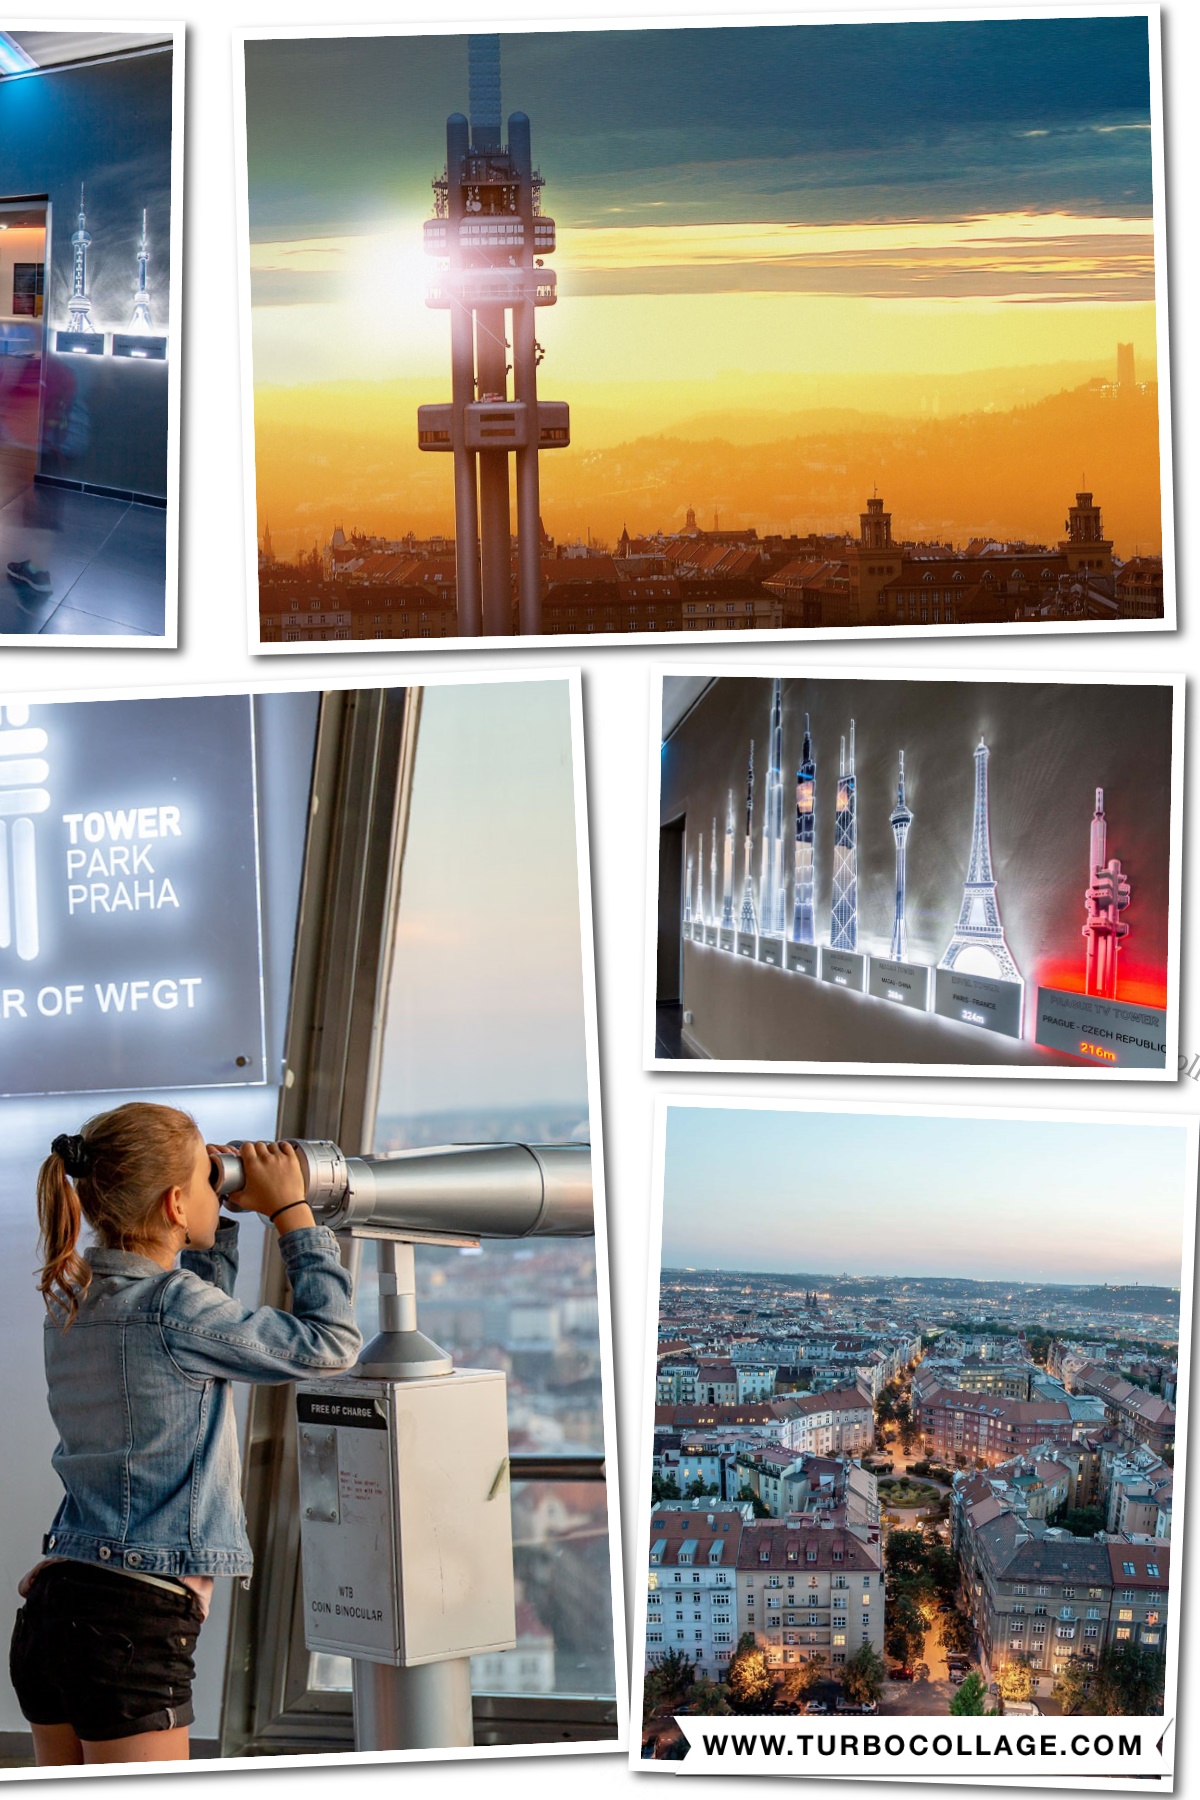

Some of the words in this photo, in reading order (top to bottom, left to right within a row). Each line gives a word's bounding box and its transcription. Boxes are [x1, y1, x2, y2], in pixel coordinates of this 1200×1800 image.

[63, 806, 182, 844] TOWER
[66, 844, 155, 879] PARK
[67, 878, 180, 915] PRAHA
[37, 985, 84, 1016] OF
[95, 977, 202, 1013] WFGT
[952, 993, 969, 1003] PARIS
[972, 998, 997, 1011] FRANCE
[1050, 995, 1093, 1013] PRAGUE
[1095, 1004, 1111, 1016] TV
[1112, 1008, 1160, 1028] TOWER
[962, 1010, 984, 1023] 324m
[1042, 1014, 1076, 1030] PRAGUE
[1081, 1024, 1114, 1040] CZECH
[1115, 1033, 1166, 1054] REPUBLIC
[1080, 1042, 1116, 1061] 216m
[311, 1404, 330, 1414] FREE
[331, 1405, 341, 1415] OF
[342, 1406, 372, 1417] CHARGE
[312, 1601, 331, 1614] COIN
[335, 1604, 383, 1622] BINOCULAR
